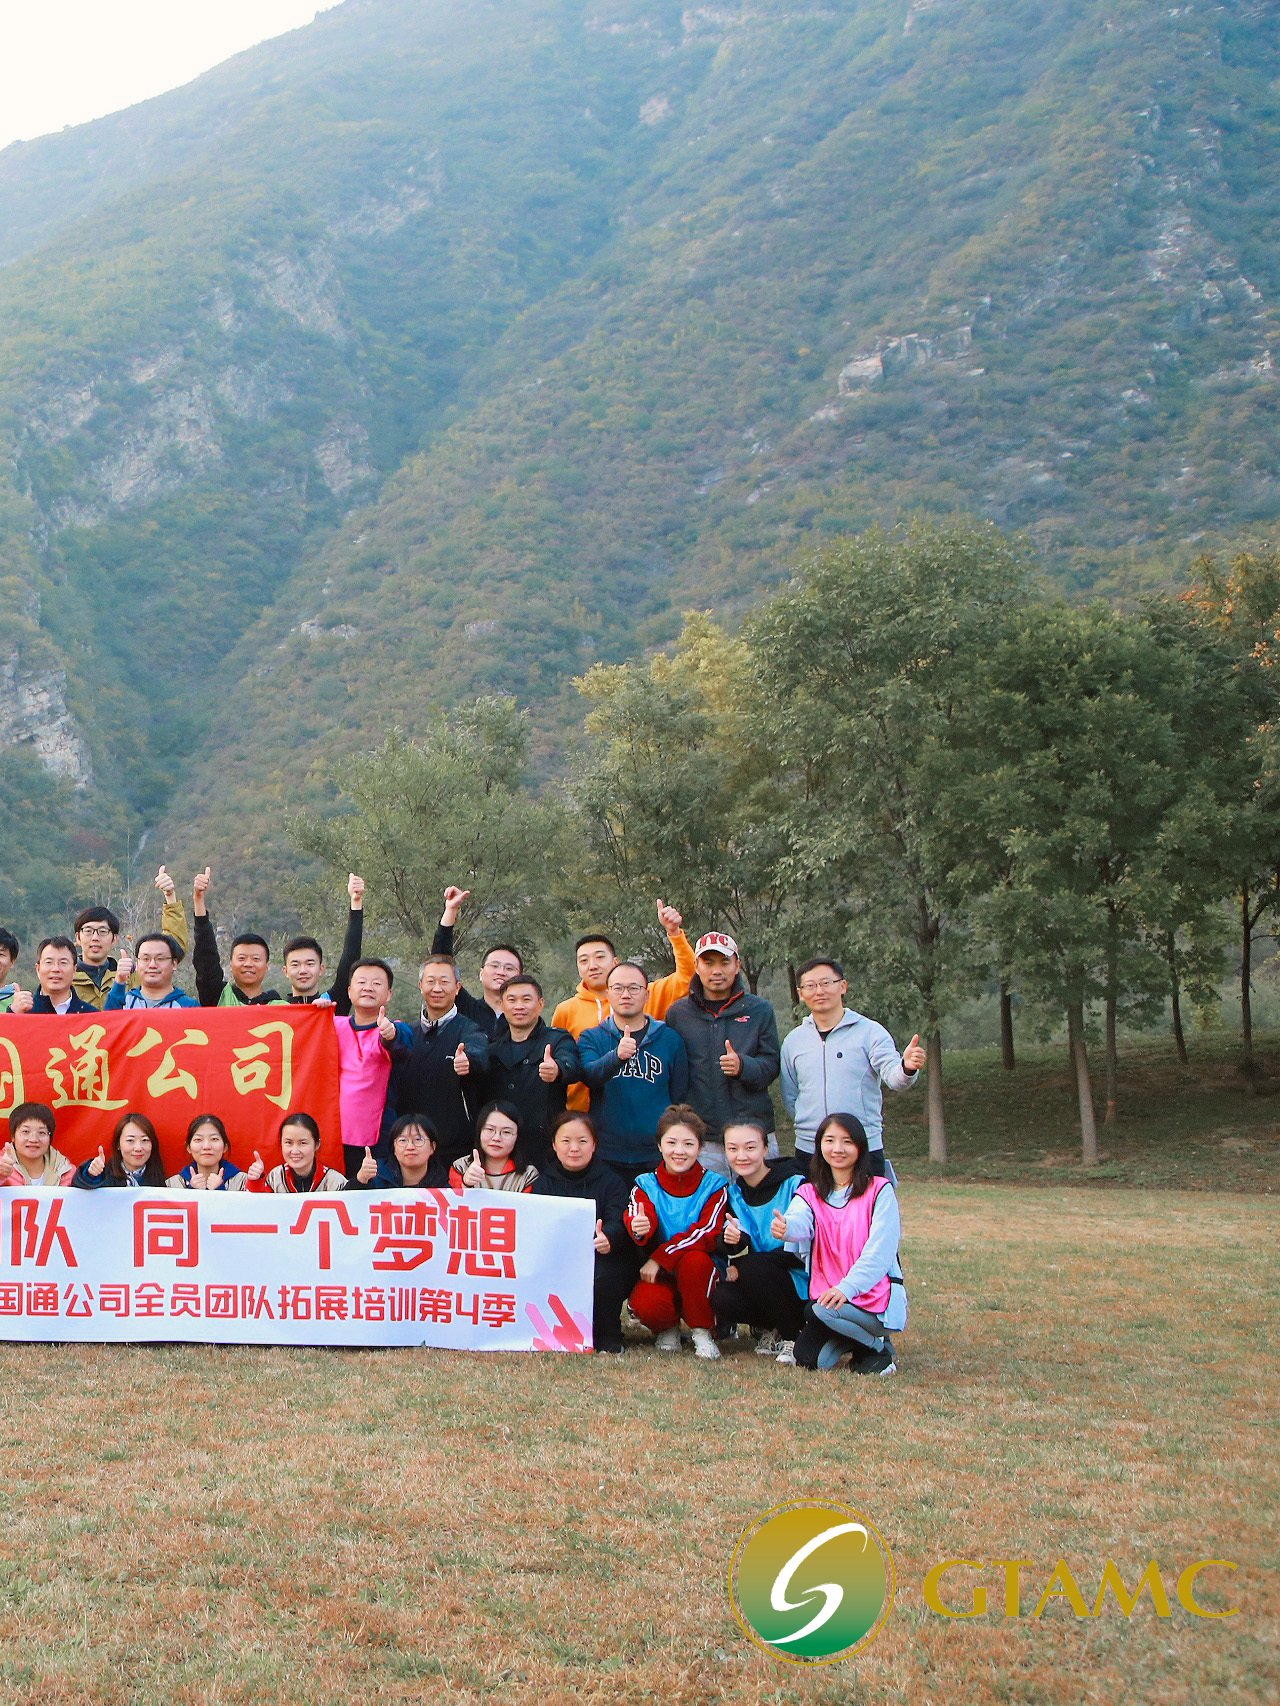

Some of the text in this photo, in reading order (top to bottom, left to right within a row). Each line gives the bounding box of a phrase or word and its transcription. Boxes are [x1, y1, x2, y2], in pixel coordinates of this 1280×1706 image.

[699, 933, 728, 949] NYC
[612, 1048, 663, 1084] AP
[133, 1199, 517, 1279] 同一个梦想
